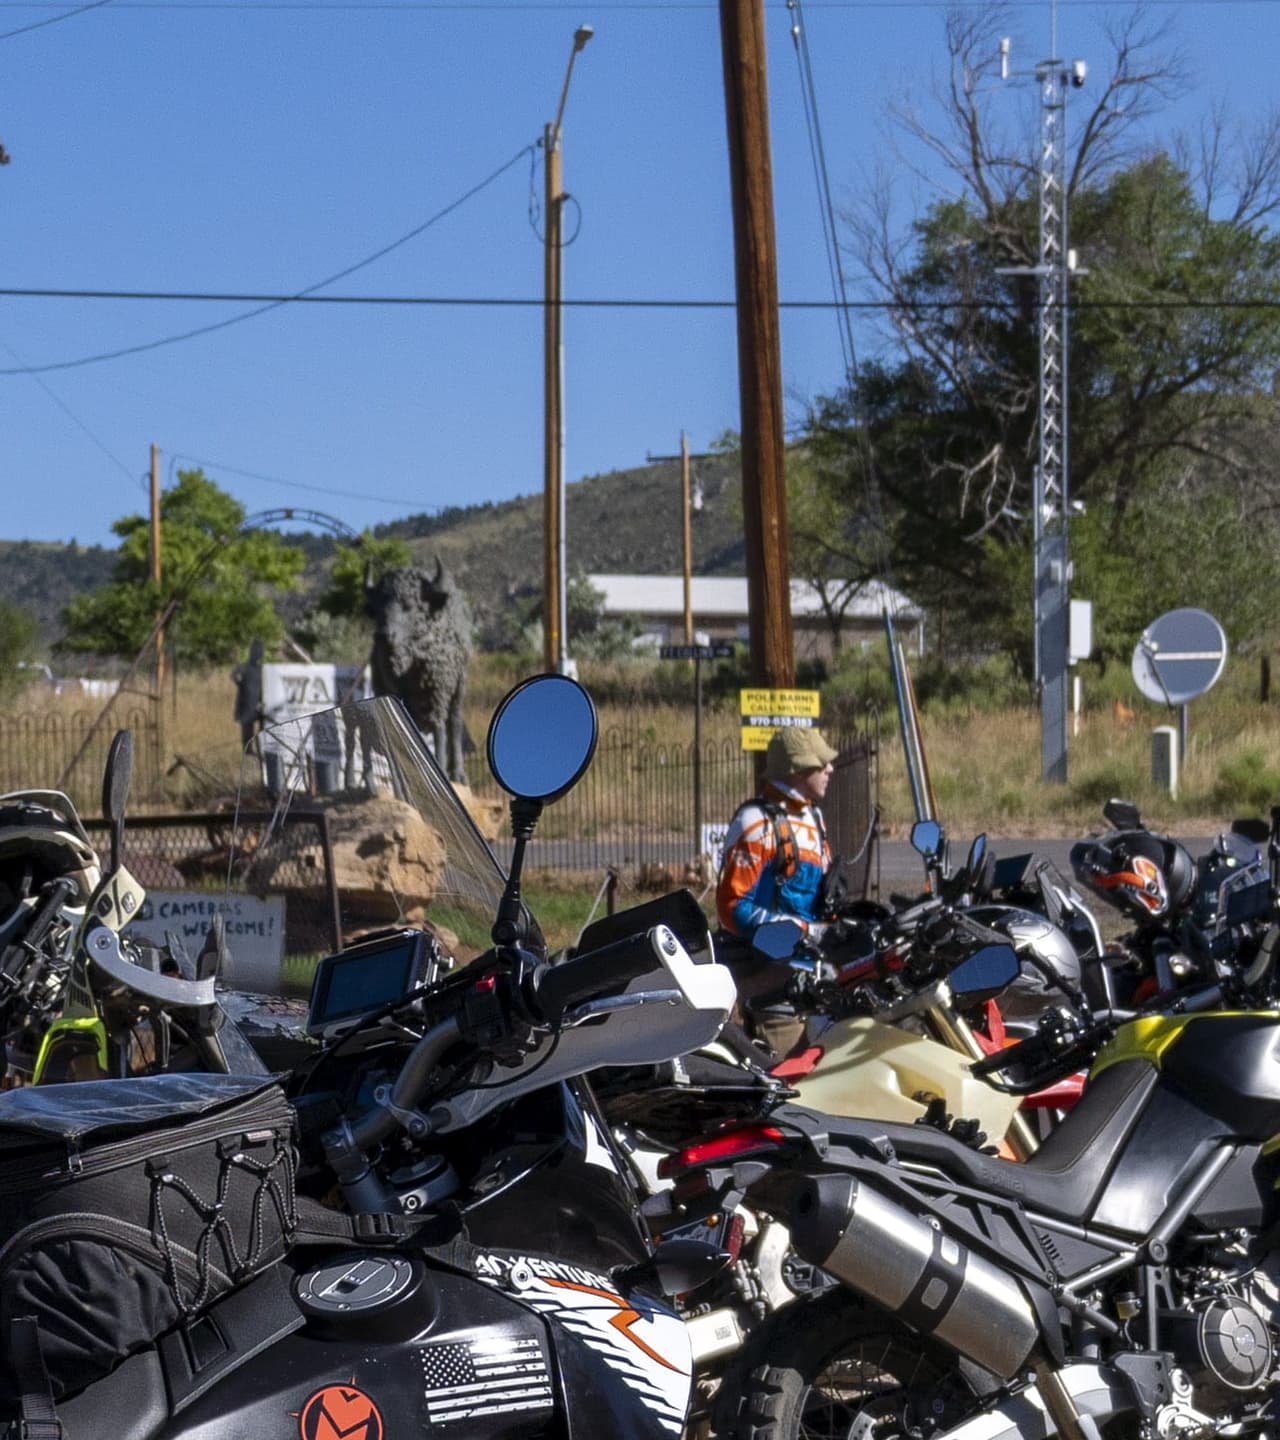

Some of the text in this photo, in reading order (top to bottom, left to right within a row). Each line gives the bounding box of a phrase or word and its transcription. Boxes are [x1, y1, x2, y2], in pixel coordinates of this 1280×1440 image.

[747, 693, 815, 704] POLE BARNS
[750, 704, 773, 712] CALL
[183, 918, 273, 937] WECOME!
